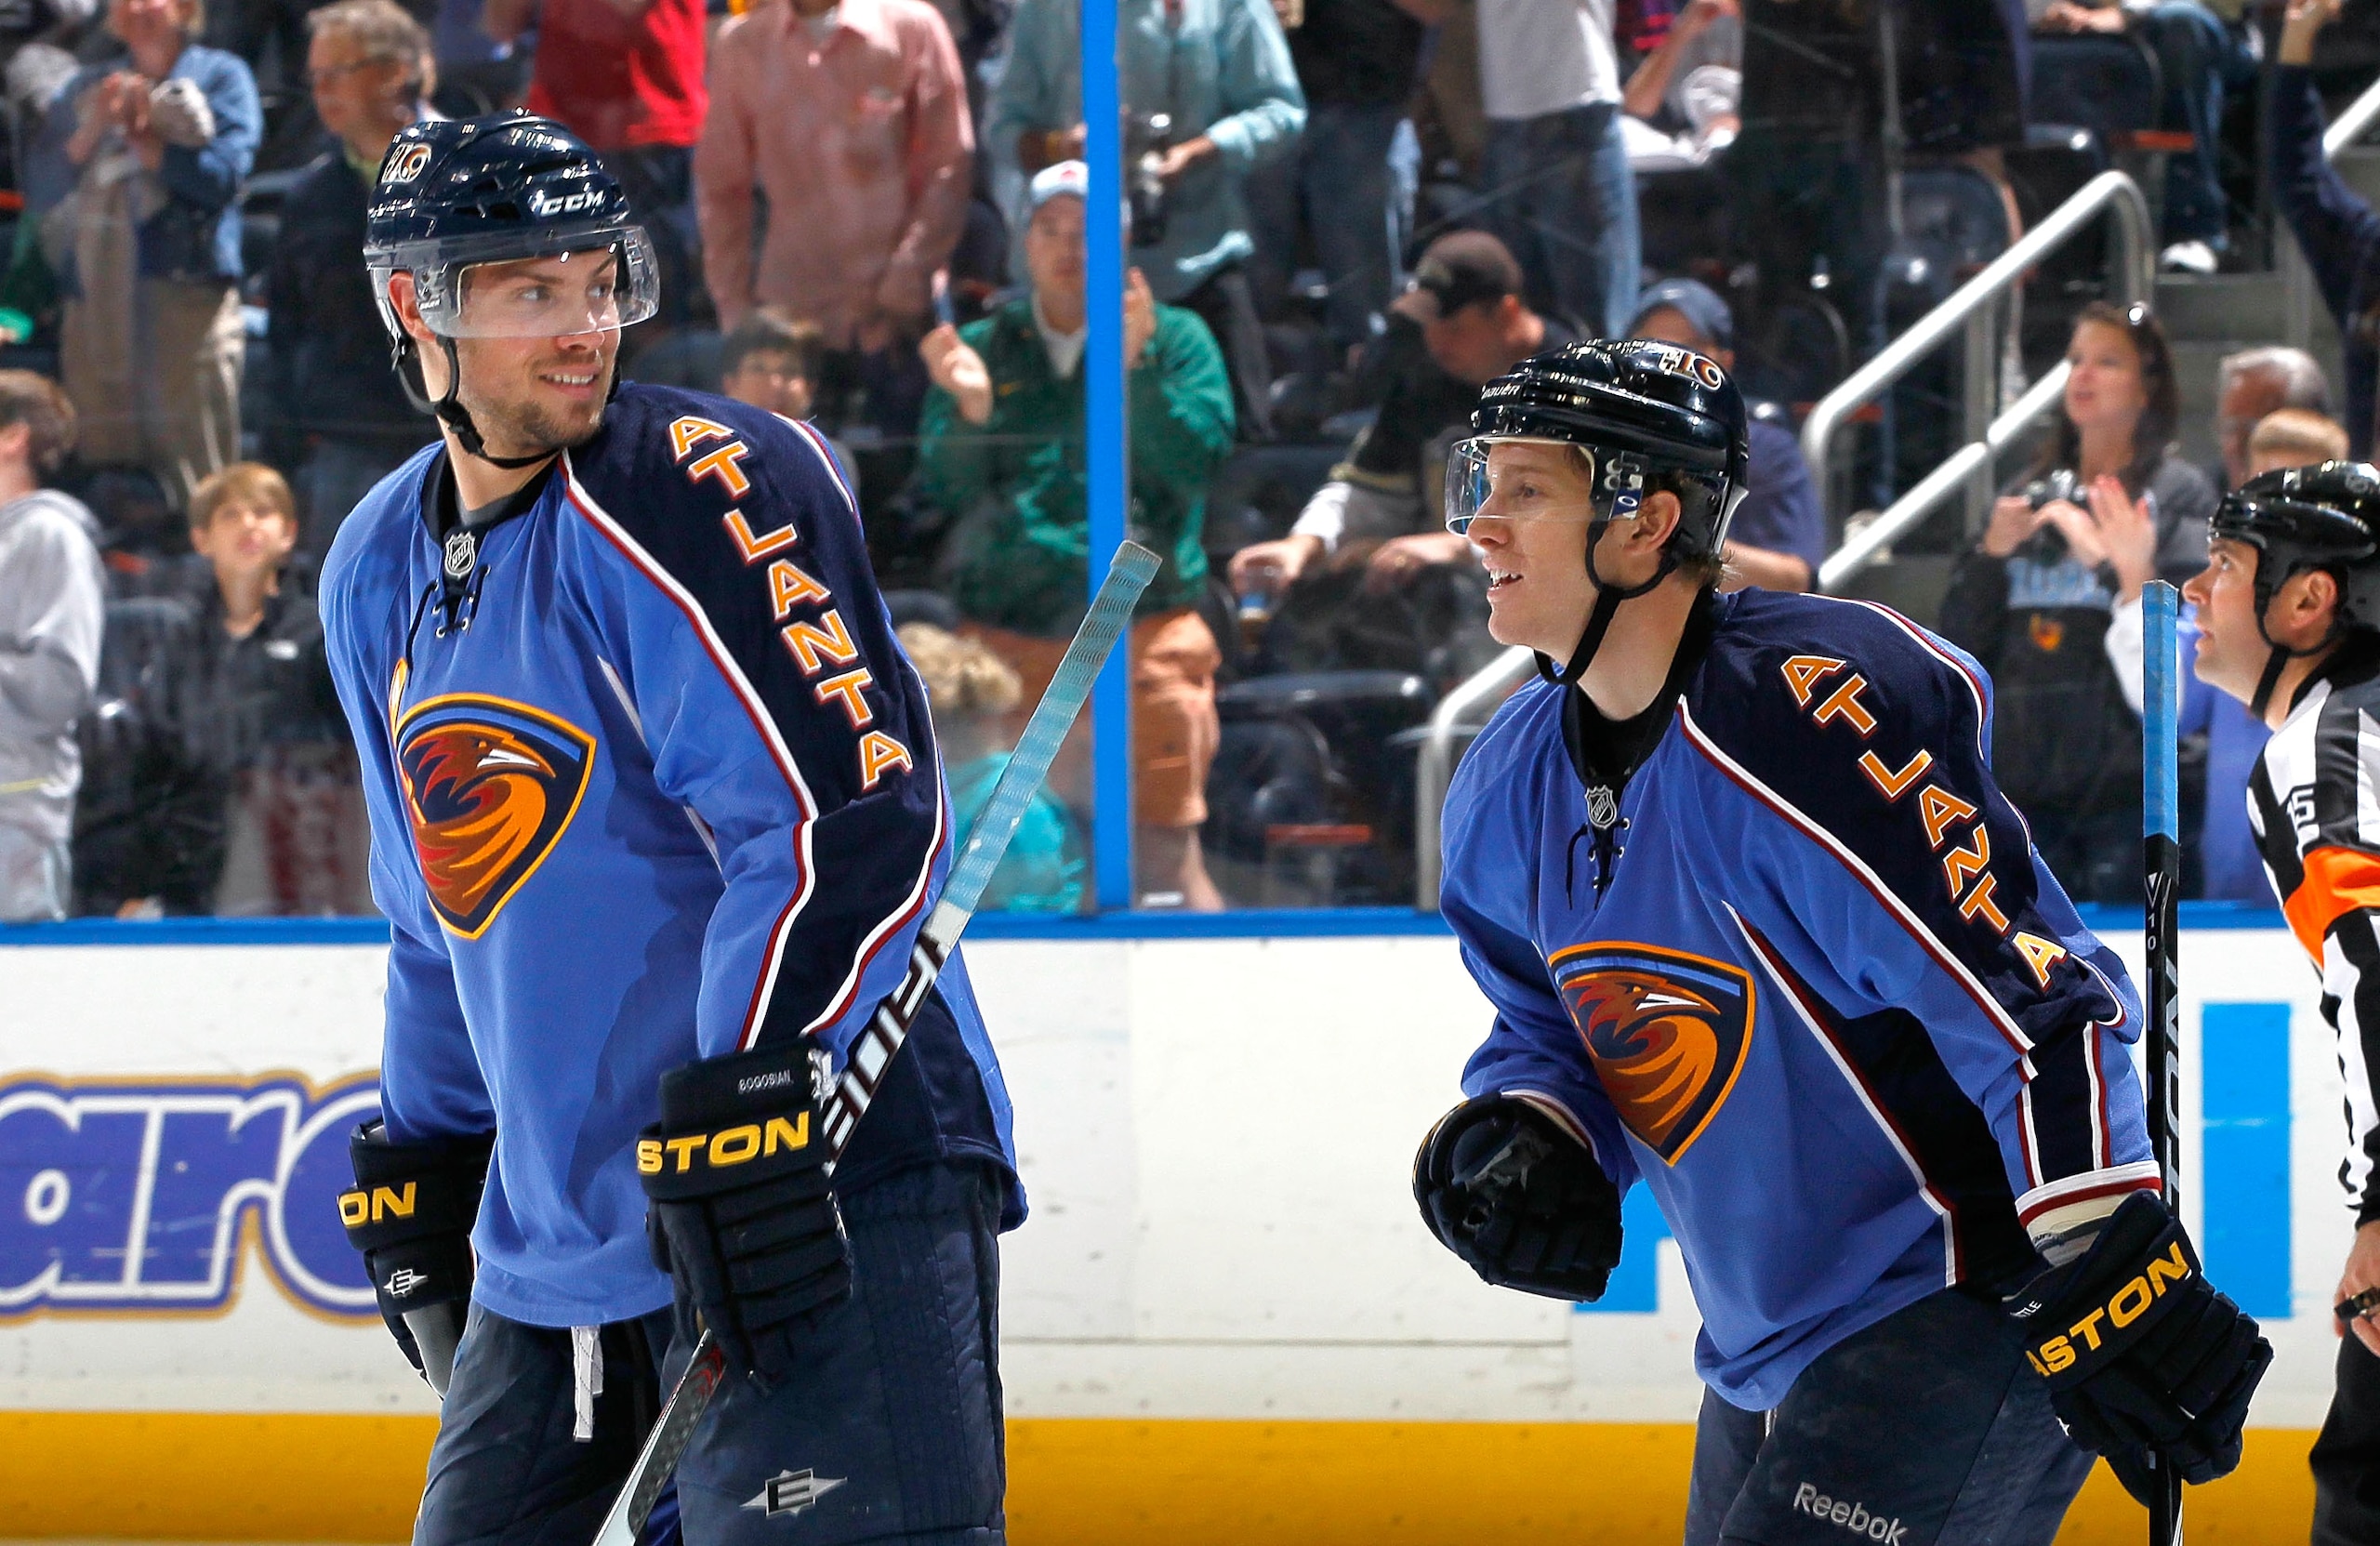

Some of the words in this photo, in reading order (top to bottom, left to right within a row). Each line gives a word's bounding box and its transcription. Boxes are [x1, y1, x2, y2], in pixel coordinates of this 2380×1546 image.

[540, 192, 605, 216] CCM
[666, 415, 914, 792] ATLANTA
[1780, 654, 2068, 991] ATLANTA
[636, 1111, 810, 1175] STON
[1793, 1482, 1908, 1546] Reebok
